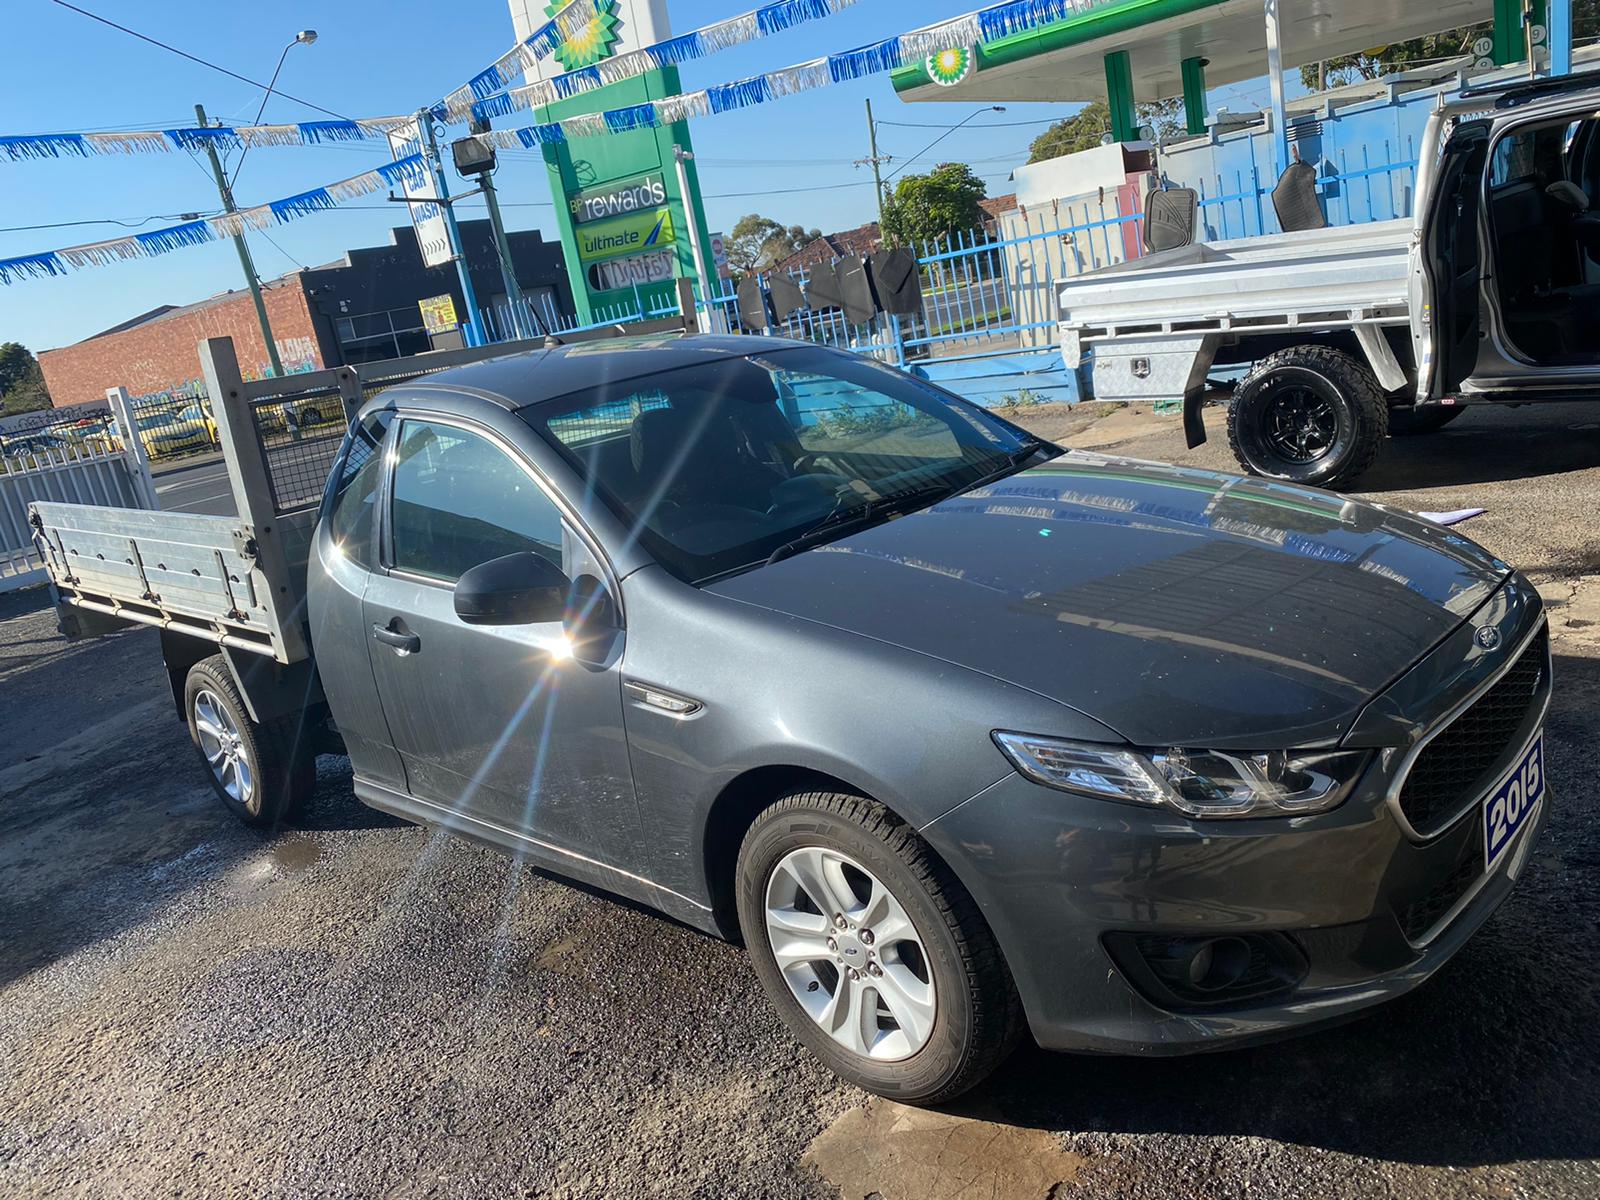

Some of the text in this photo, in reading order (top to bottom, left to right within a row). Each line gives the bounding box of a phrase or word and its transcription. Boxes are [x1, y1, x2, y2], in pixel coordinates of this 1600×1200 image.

[1532, 29, 1540, 40] 9
[1476, 40, 1490, 52] 10
[408, 171, 427, 192] CAR
[569, 177, 666, 219] BP rewards
[413, 201, 440, 223] WASH
[585, 230, 639, 253] ultimate
[1490, 748, 1539, 850] 2015
